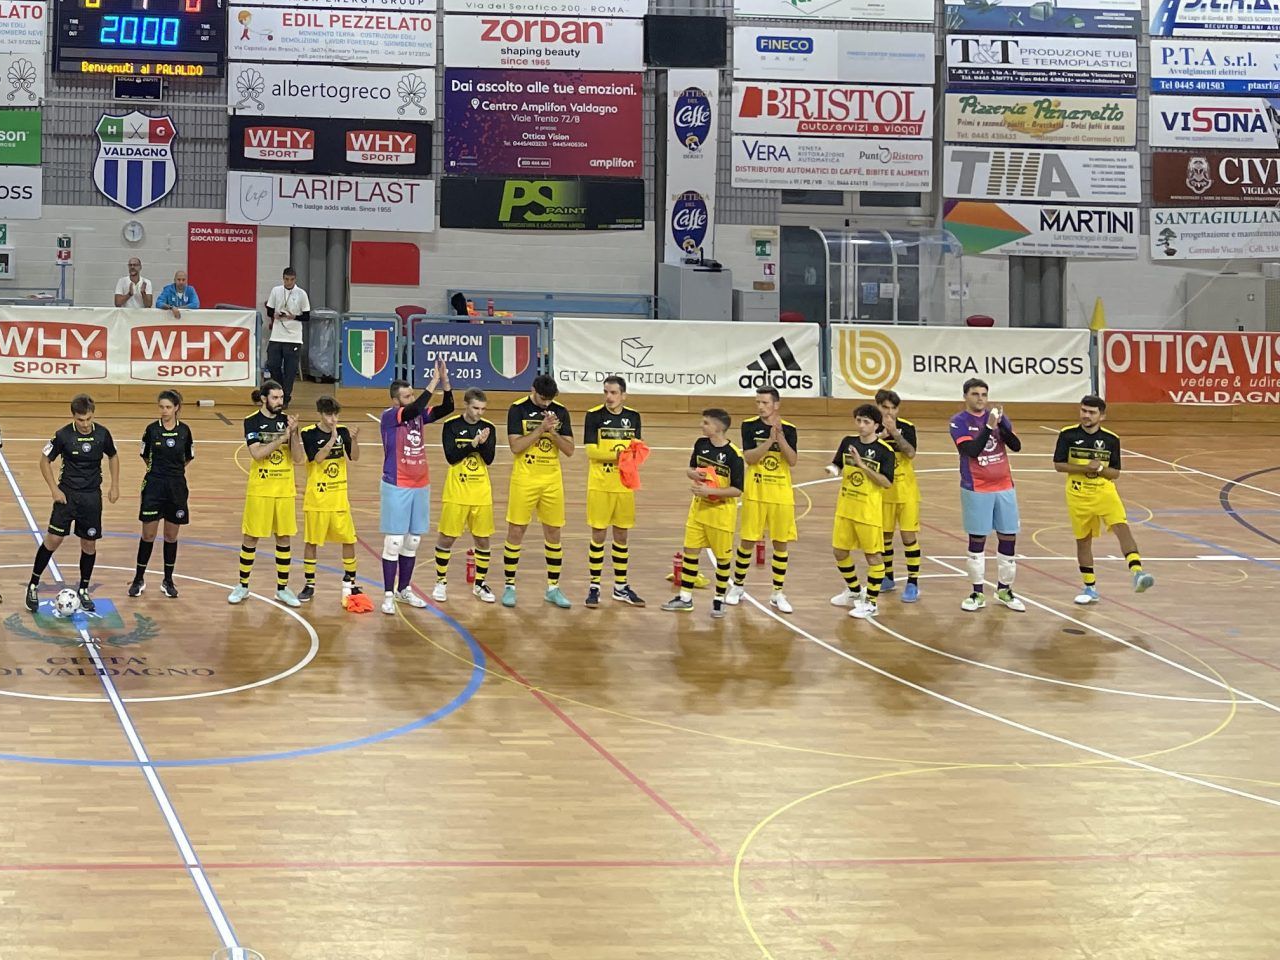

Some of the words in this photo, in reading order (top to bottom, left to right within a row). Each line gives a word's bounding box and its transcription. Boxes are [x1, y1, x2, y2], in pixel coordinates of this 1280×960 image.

[283, 13, 323, 27] EDIL
[329, 15, 431, 31] PEZZELATO
[100, 16, 180, 45] 2000
[761, 39, 809, 50] FINECO
[951, 39, 1019, 64] T&T
[501, 48, 542, 57] shaping
[545, 48, 580, 57] beauty
[1020, 48, 1101, 57] PRODUZIONE
[1106, 50, 1132, 58] TUBI
[1162, 48, 1215, 66] P.T.A
[1224, 53, 1257, 66] s.r.l.
[81, 61, 133, 73] Benvenuti
[140, 65, 149, 73] al
[156, 65, 203, 75] PALALIDO
[1034, 58, 1131, 67] TERMOPLASTICI
[272, 80, 391, 102] albertogreco
[451, 80, 472, 91] Dai
[477, 82, 522, 93] ascolto
[527, 83, 549, 93] alle
[553, 84, 574, 94] tue
[578, 84, 637, 95] emozioni.
[1175, 81, 1194, 89] 0445
[1196, 82, 1225, 90] 401503
[482, 101, 518, 111] Centro
[521, 102, 567, 113] Amplifon
[570, 104, 618, 115] Valdagno
[766, 87, 925, 122] BRISTOL
[960, 96, 1028, 115] Pizzeria
[1034, 99, 1123, 121] Panaretto
[675, 105, 710, 128] Caffè
[801, 122, 868, 132] autoservizi
[884, 124, 919, 134] viaggi
[248, 129, 311, 148] WHY
[351, 133, 412, 151] WHY
[103, 147, 167, 157] VALDAGNO
[259, 149, 299, 158] SPORT
[743, 140, 791, 161] VERA
[362, 154, 400, 162] SPORT
[590, 158, 634, 168] amplifon
[279, 178, 420, 203] LARIPLAST
[673, 210, 707, 231] Caffè
[1040, 209, 1133, 234] MARTINI
[137, 331, 243, 360] WHY
[422, 334, 483, 346] CAMPIONI
[427, 352, 478, 363] D'ITALIA
[1106, 335, 1234, 375] OTTICA
[13, 361, 80, 375] SPORT
[158, 366, 224, 378] SPORT
[913, 355, 978, 374] BIRRA
[985, 357, 1083, 375] INGROSS
[457, 368, 481, 379] 2013
[560, 371, 589, 382] GTZ
[739, 371, 813, 389] adidas
[1181, 377, 1228, 387] vedere
[36, 668, 214, 676] VALDAGNO
